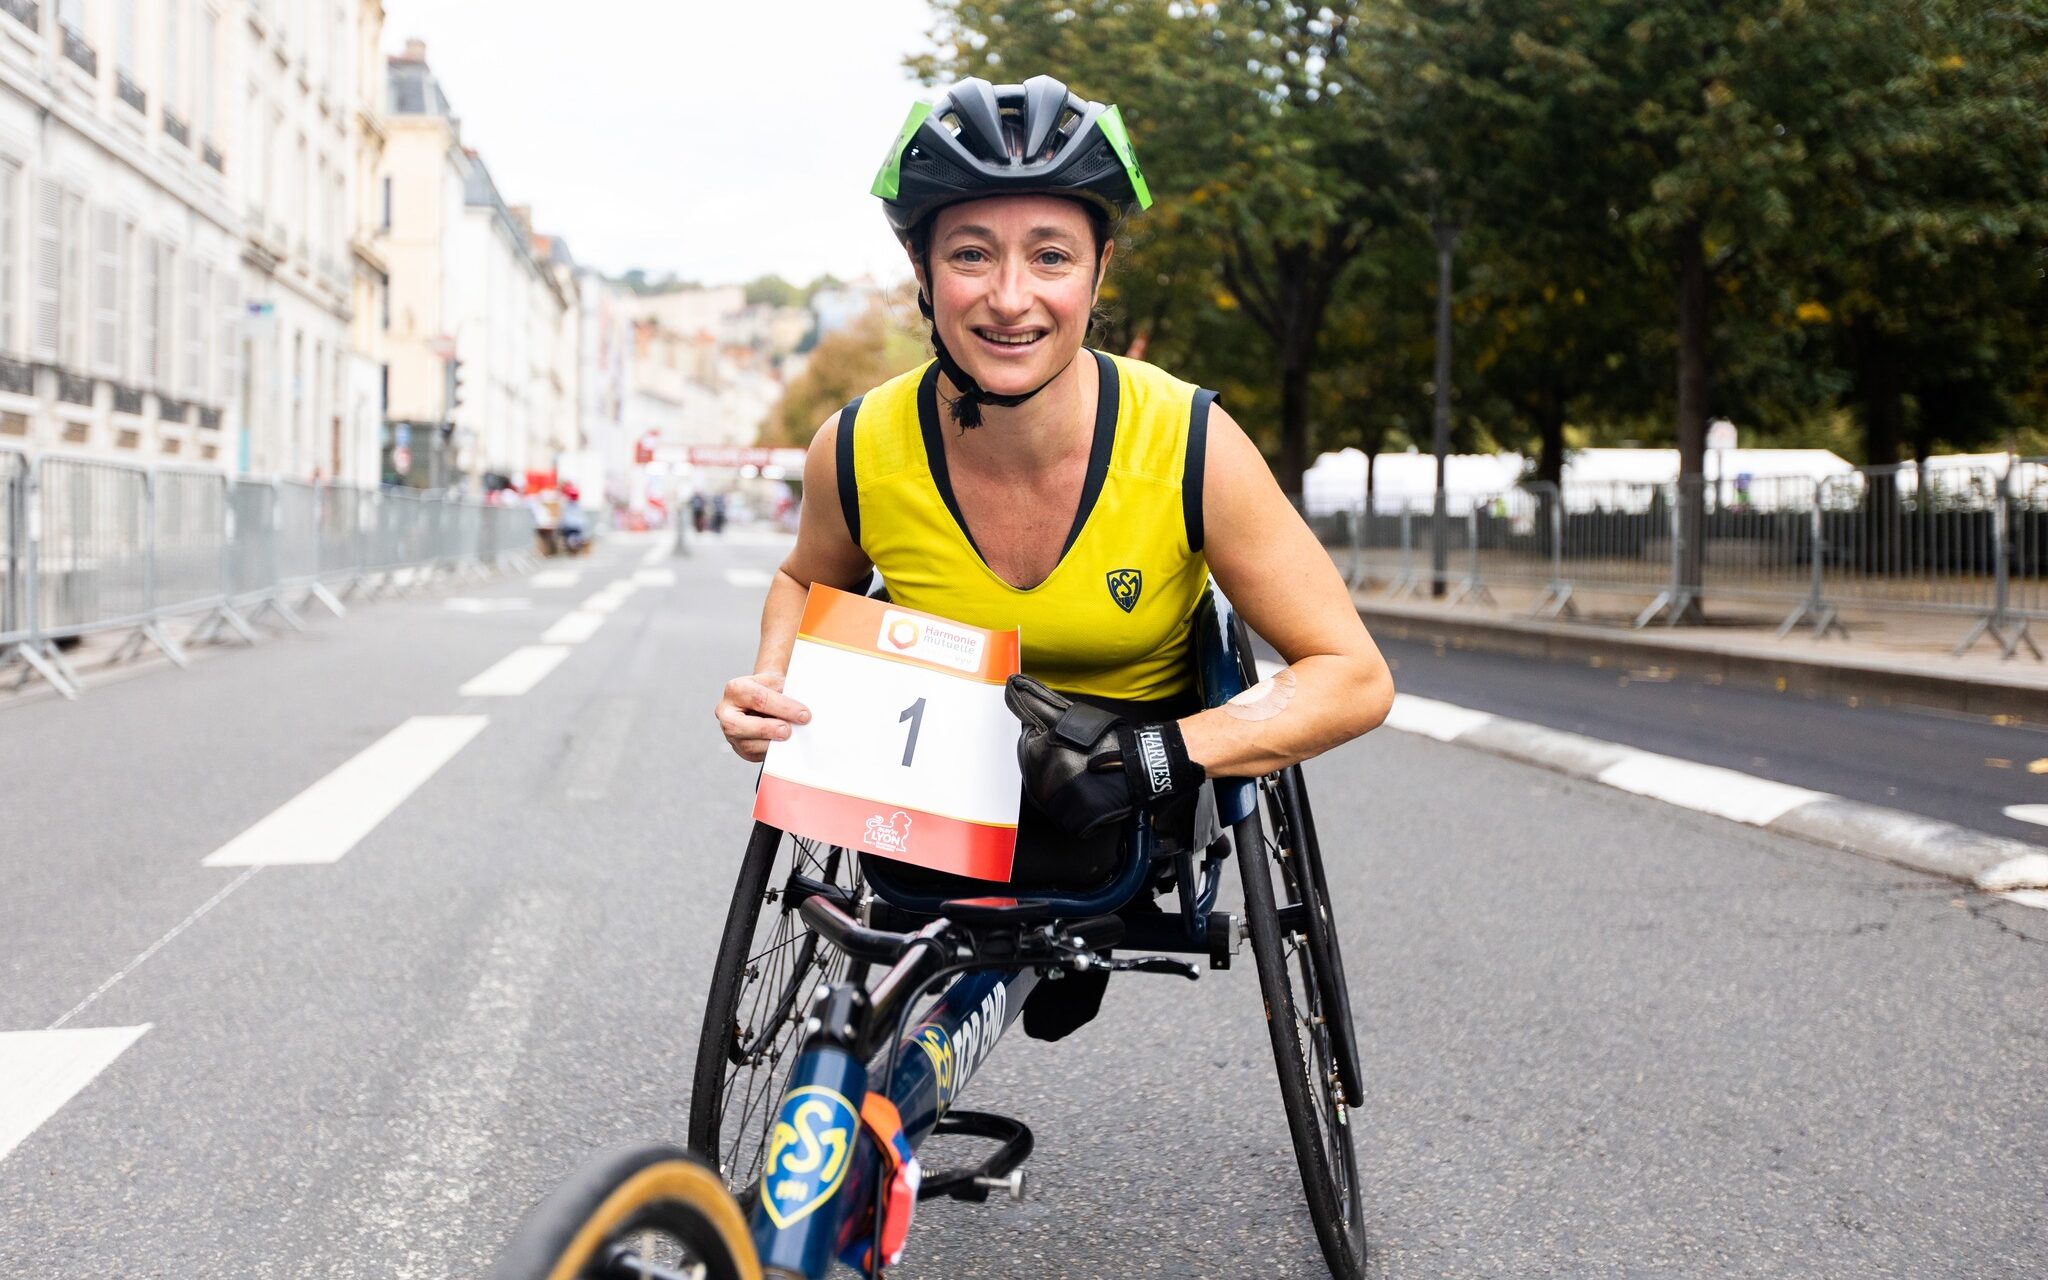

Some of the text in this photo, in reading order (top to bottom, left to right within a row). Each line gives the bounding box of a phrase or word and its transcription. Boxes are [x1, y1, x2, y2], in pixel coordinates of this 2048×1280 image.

[923, 635, 976, 655] mutuelle
[925, 625, 977, 647] Harmonie
[898, 697, 926, 767] 1
[1140, 731, 1173, 793] HARNESS
[871, 830, 901, 846] LYON
[949, 981, 1006, 1103] TOP END
